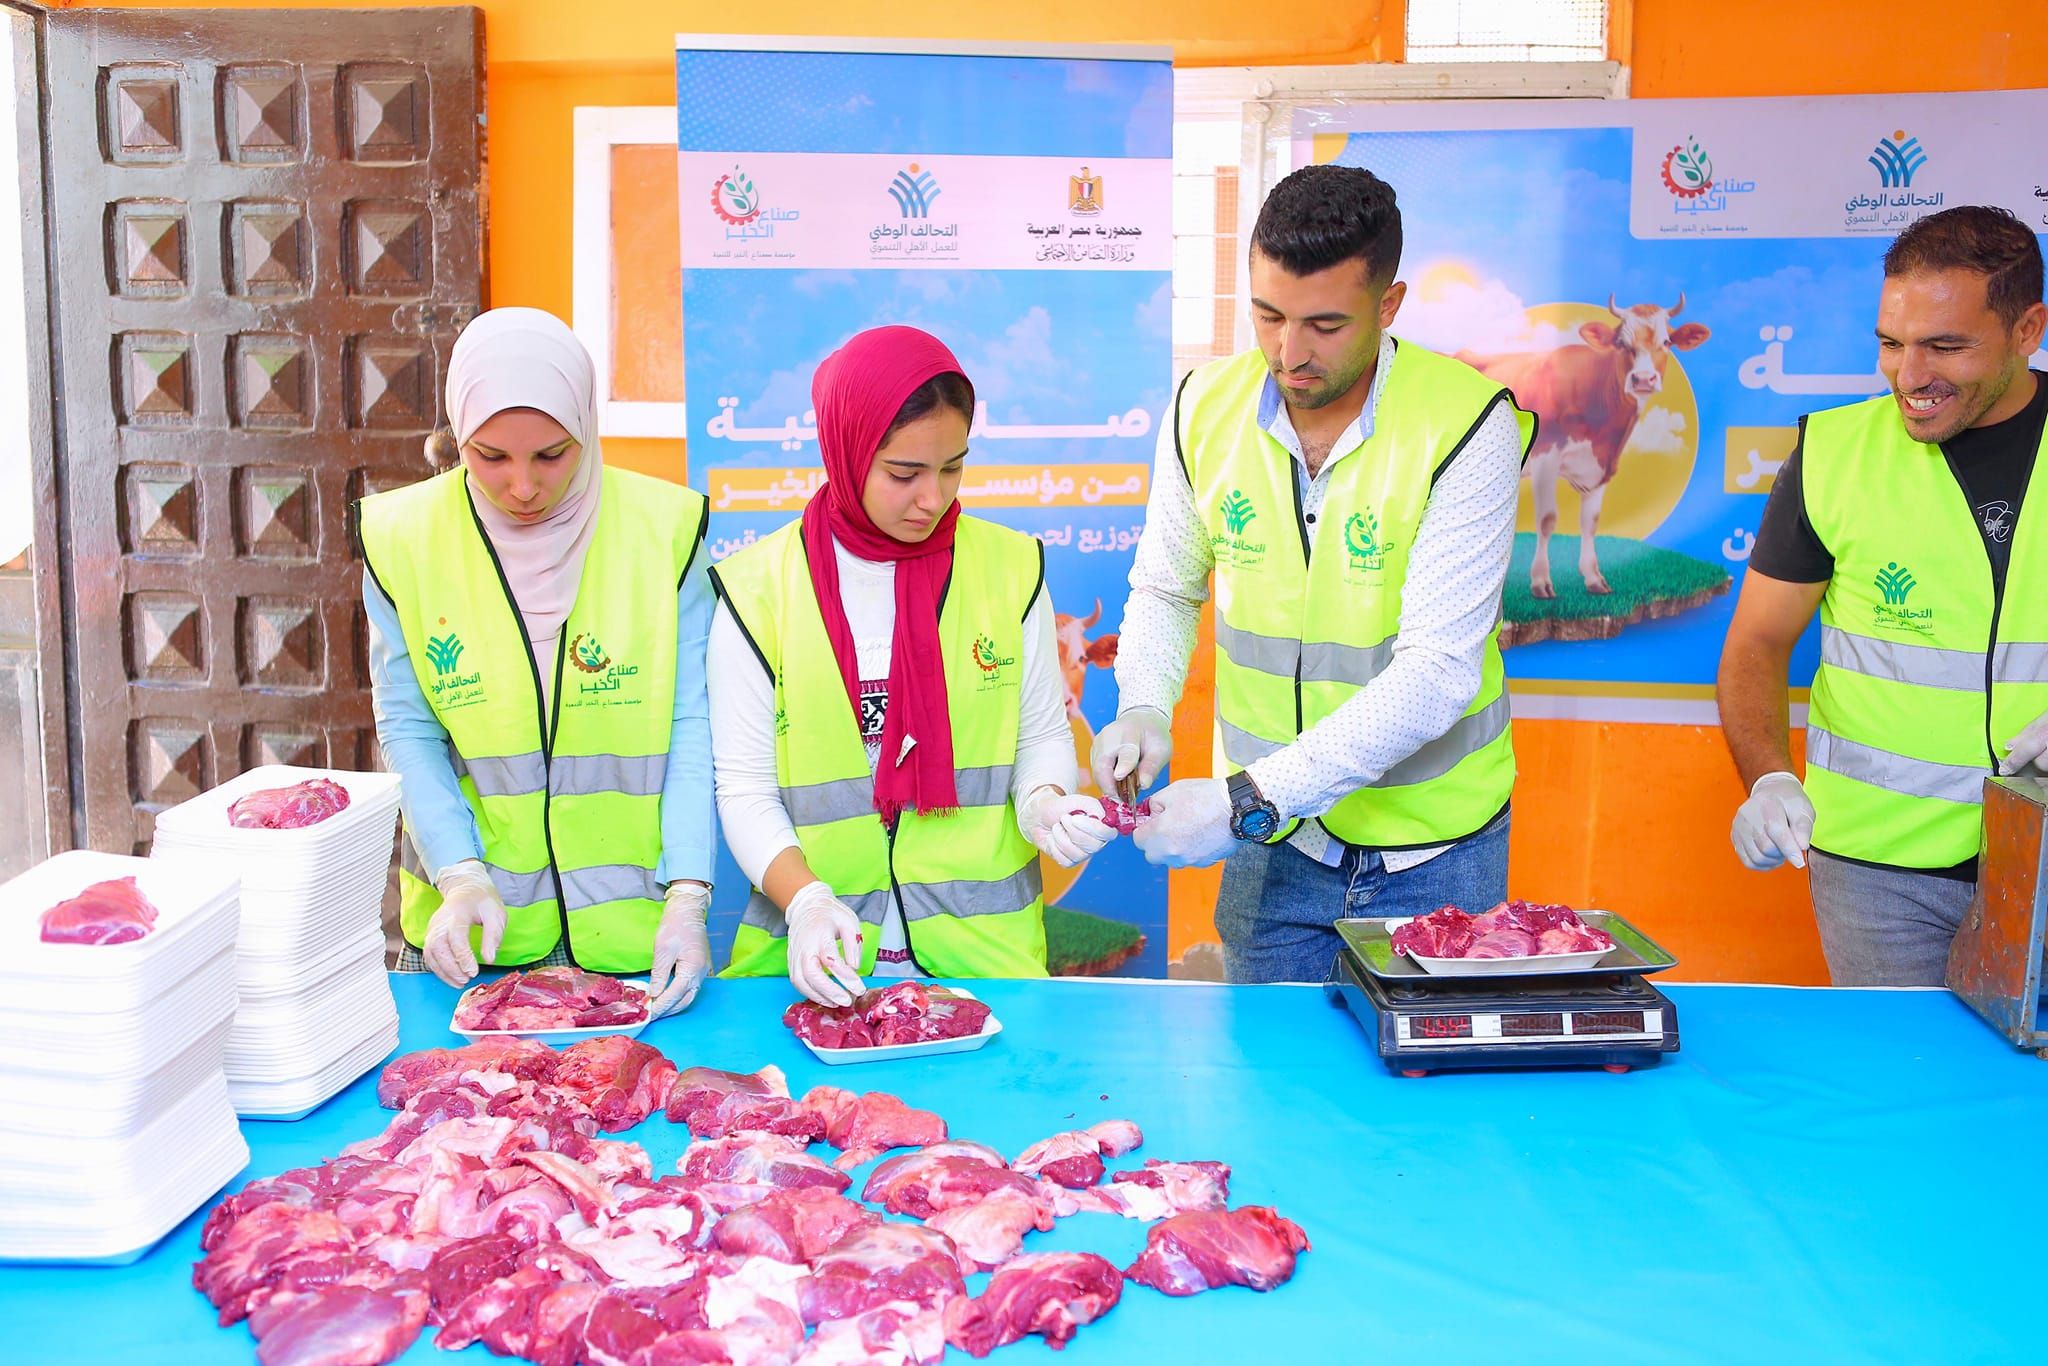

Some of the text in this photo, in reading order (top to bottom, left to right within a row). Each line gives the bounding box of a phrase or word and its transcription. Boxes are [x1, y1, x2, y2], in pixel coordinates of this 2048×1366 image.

[1709, 178, 1755, 202] صناع
[1845, 192, 1944, 214] التحالف الوطني
[757, 207, 800, 229] صناع
[869, 223, 958, 243] التحالف الوطني
[1026, 222, 1142, 240] جمهورية مصر العربية
[1081, 475, 1142, 503] من
[447, 671, 481, 689] التحالف
[606, 664, 638, 683] صناع
[580, 678, 620, 695] الخير
